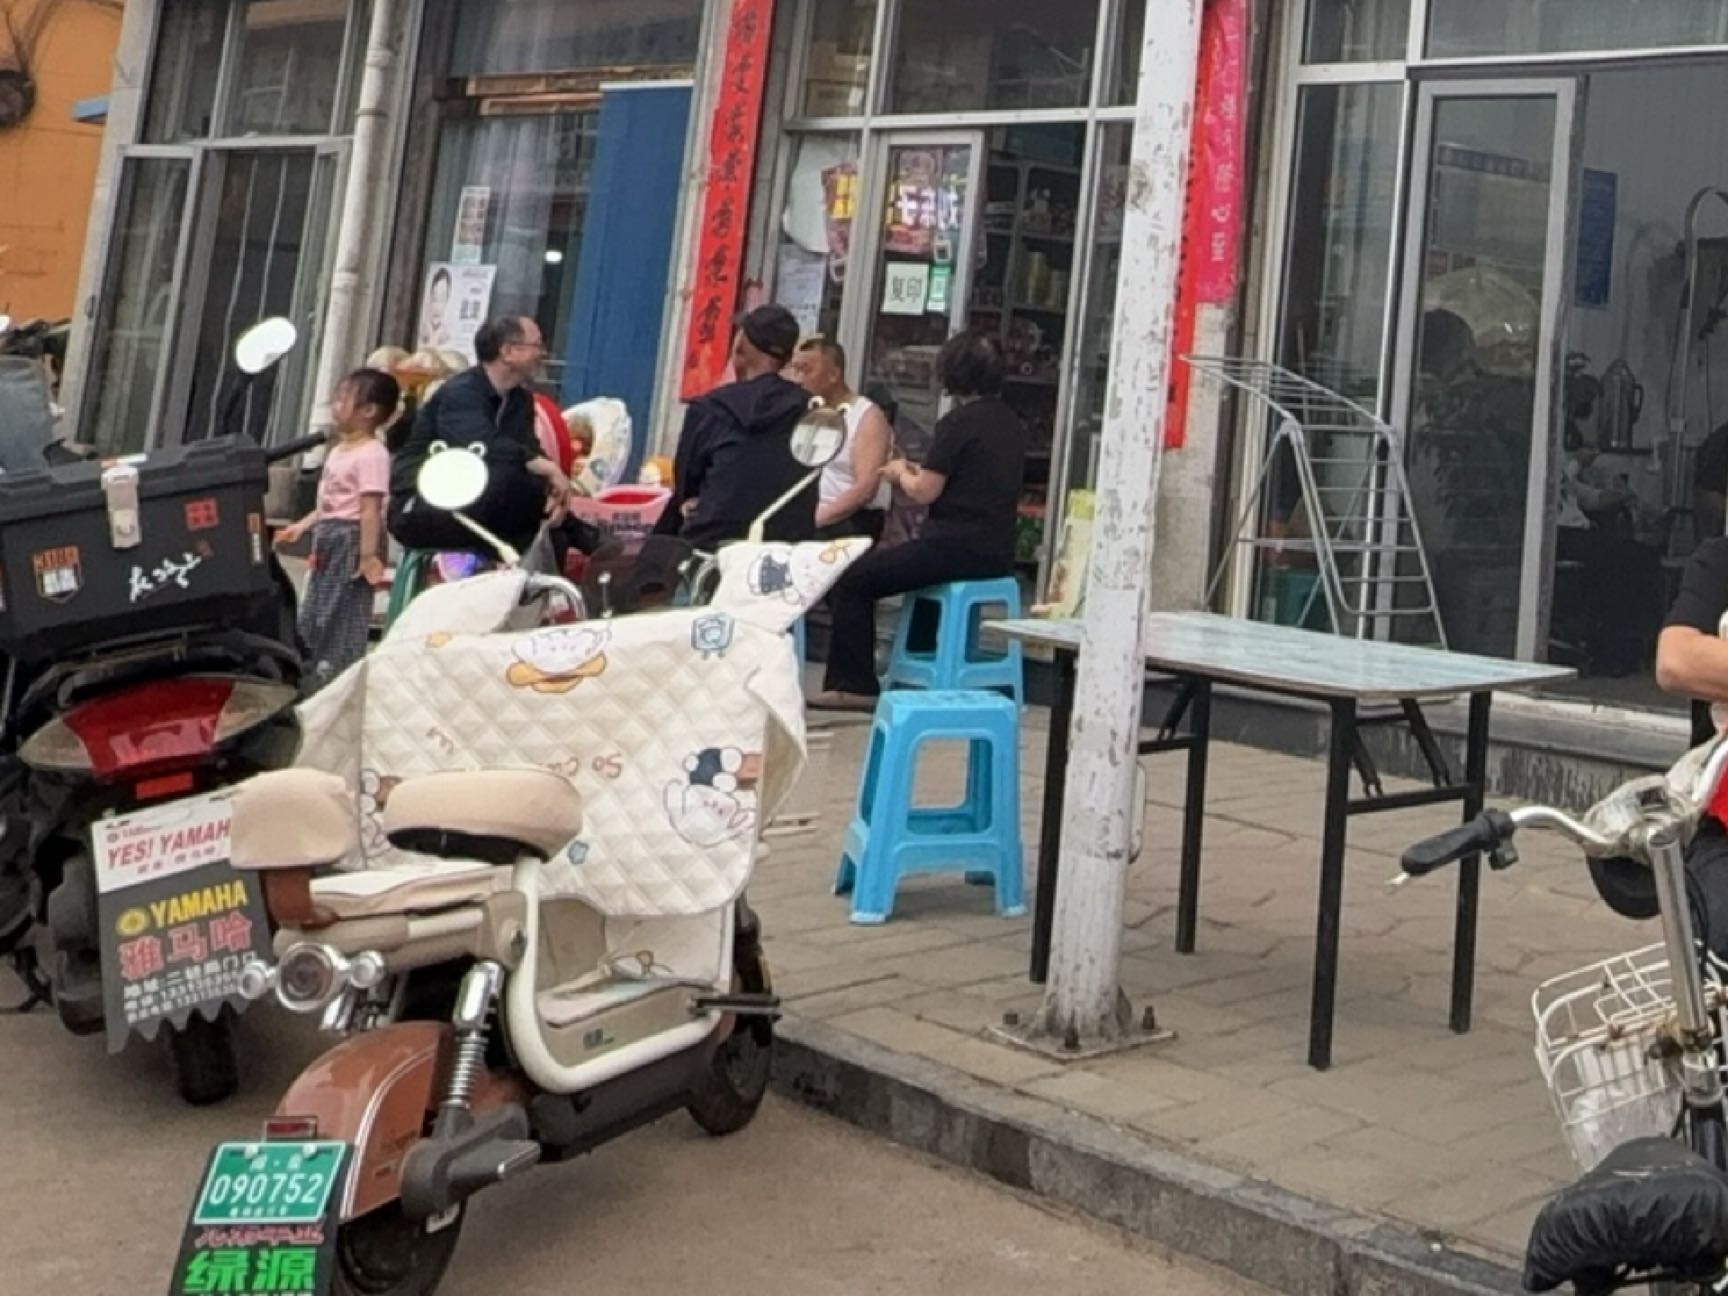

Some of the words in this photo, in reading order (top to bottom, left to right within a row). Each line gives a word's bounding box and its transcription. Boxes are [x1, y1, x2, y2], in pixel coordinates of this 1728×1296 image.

[107, 837, 154, 870] YES!
[159, 818, 232, 856] YAMAH
[150, 879, 248, 929] YAMAHA
[208, 1172, 325, 1205] 090752
[182, 1248, 317, 1294] 绿源
